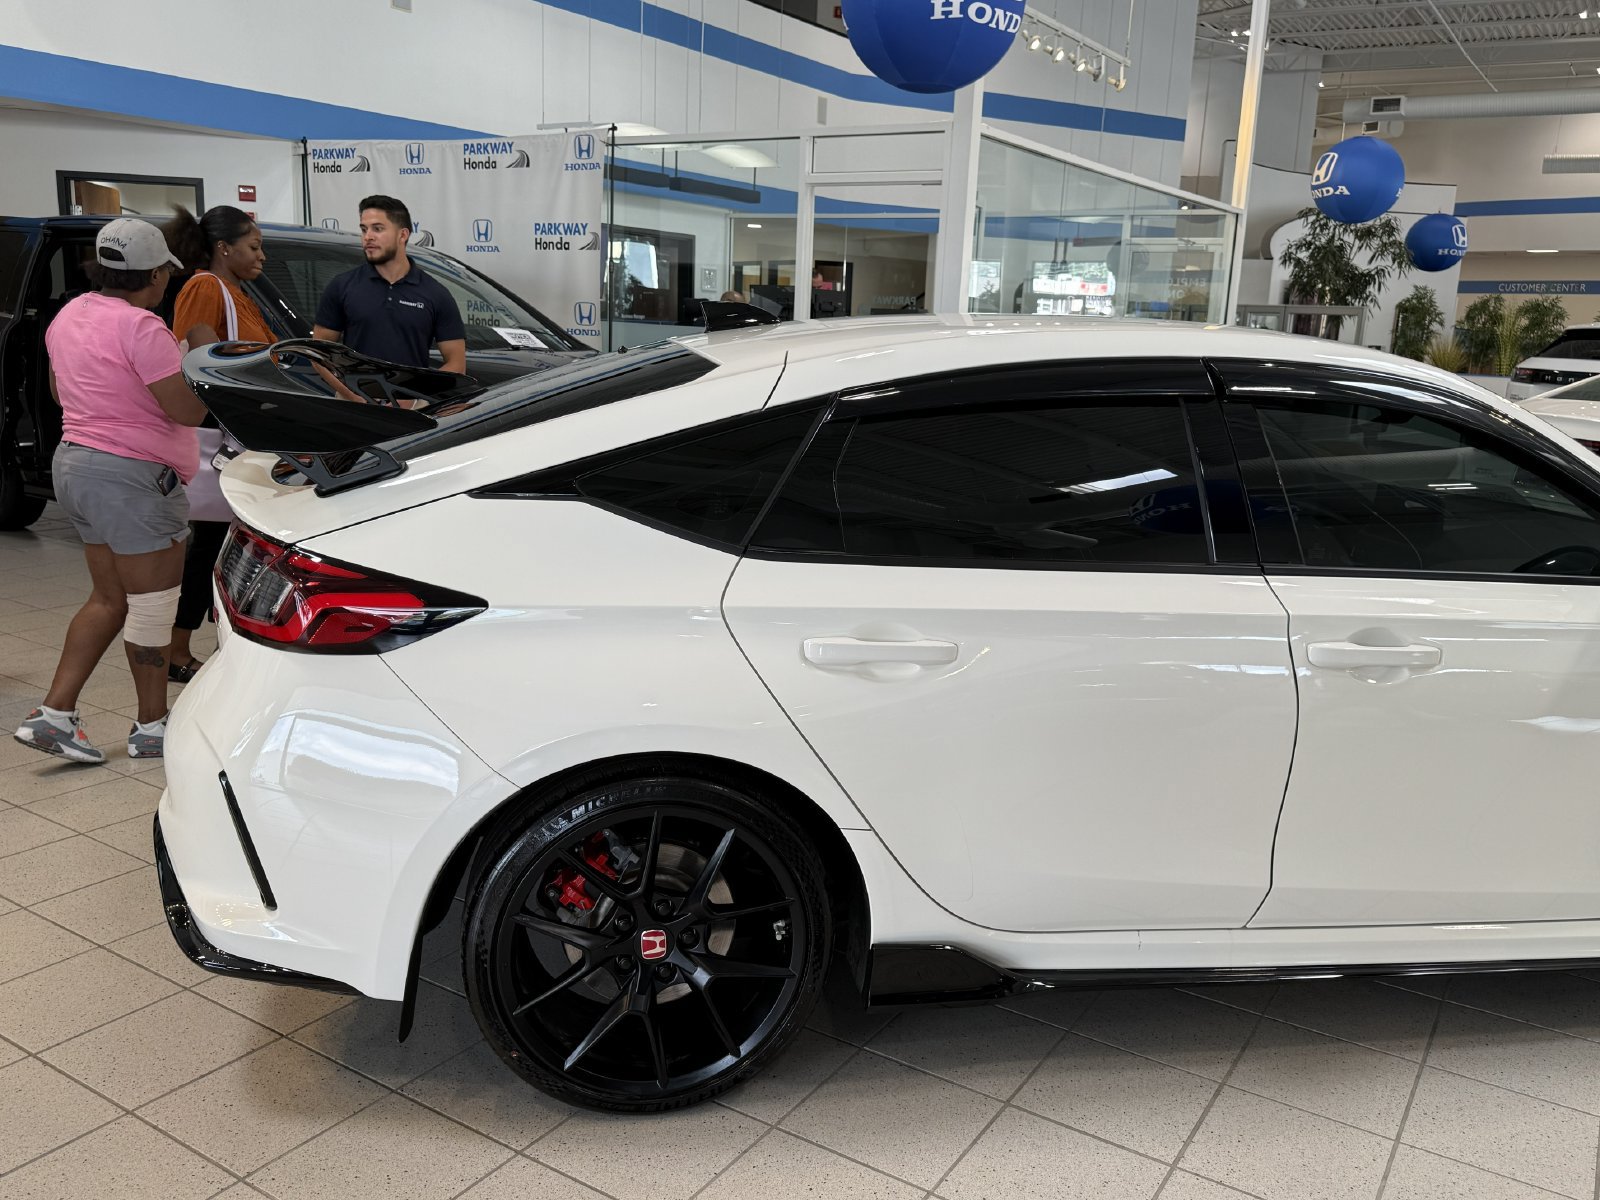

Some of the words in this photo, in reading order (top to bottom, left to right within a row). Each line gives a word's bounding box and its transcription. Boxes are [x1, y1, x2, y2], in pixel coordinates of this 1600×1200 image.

[930, 0, 1021, 34] HOND
[312, 148, 356, 159] PARKWAY
[464, 142, 514, 155] PARKWAY
[313, 162, 341, 173] Honda
[463, 157, 497, 170] Honda
[564, 162, 601, 171] HONDA
[1311, 185, 1351, 199] ONDA
[534, 223, 588, 236] PARKWAY
[100, 236, 127, 249] OHANA
[534, 237, 570, 250] Honda
[1438, 248, 1466, 256] HON
[1498, 283, 1546, 292] CUSTOMER
[1550, 283, 1586, 292] CENTER
[467, 300, 498, 313] PARK
[467, 313, 500, 327] Honda
